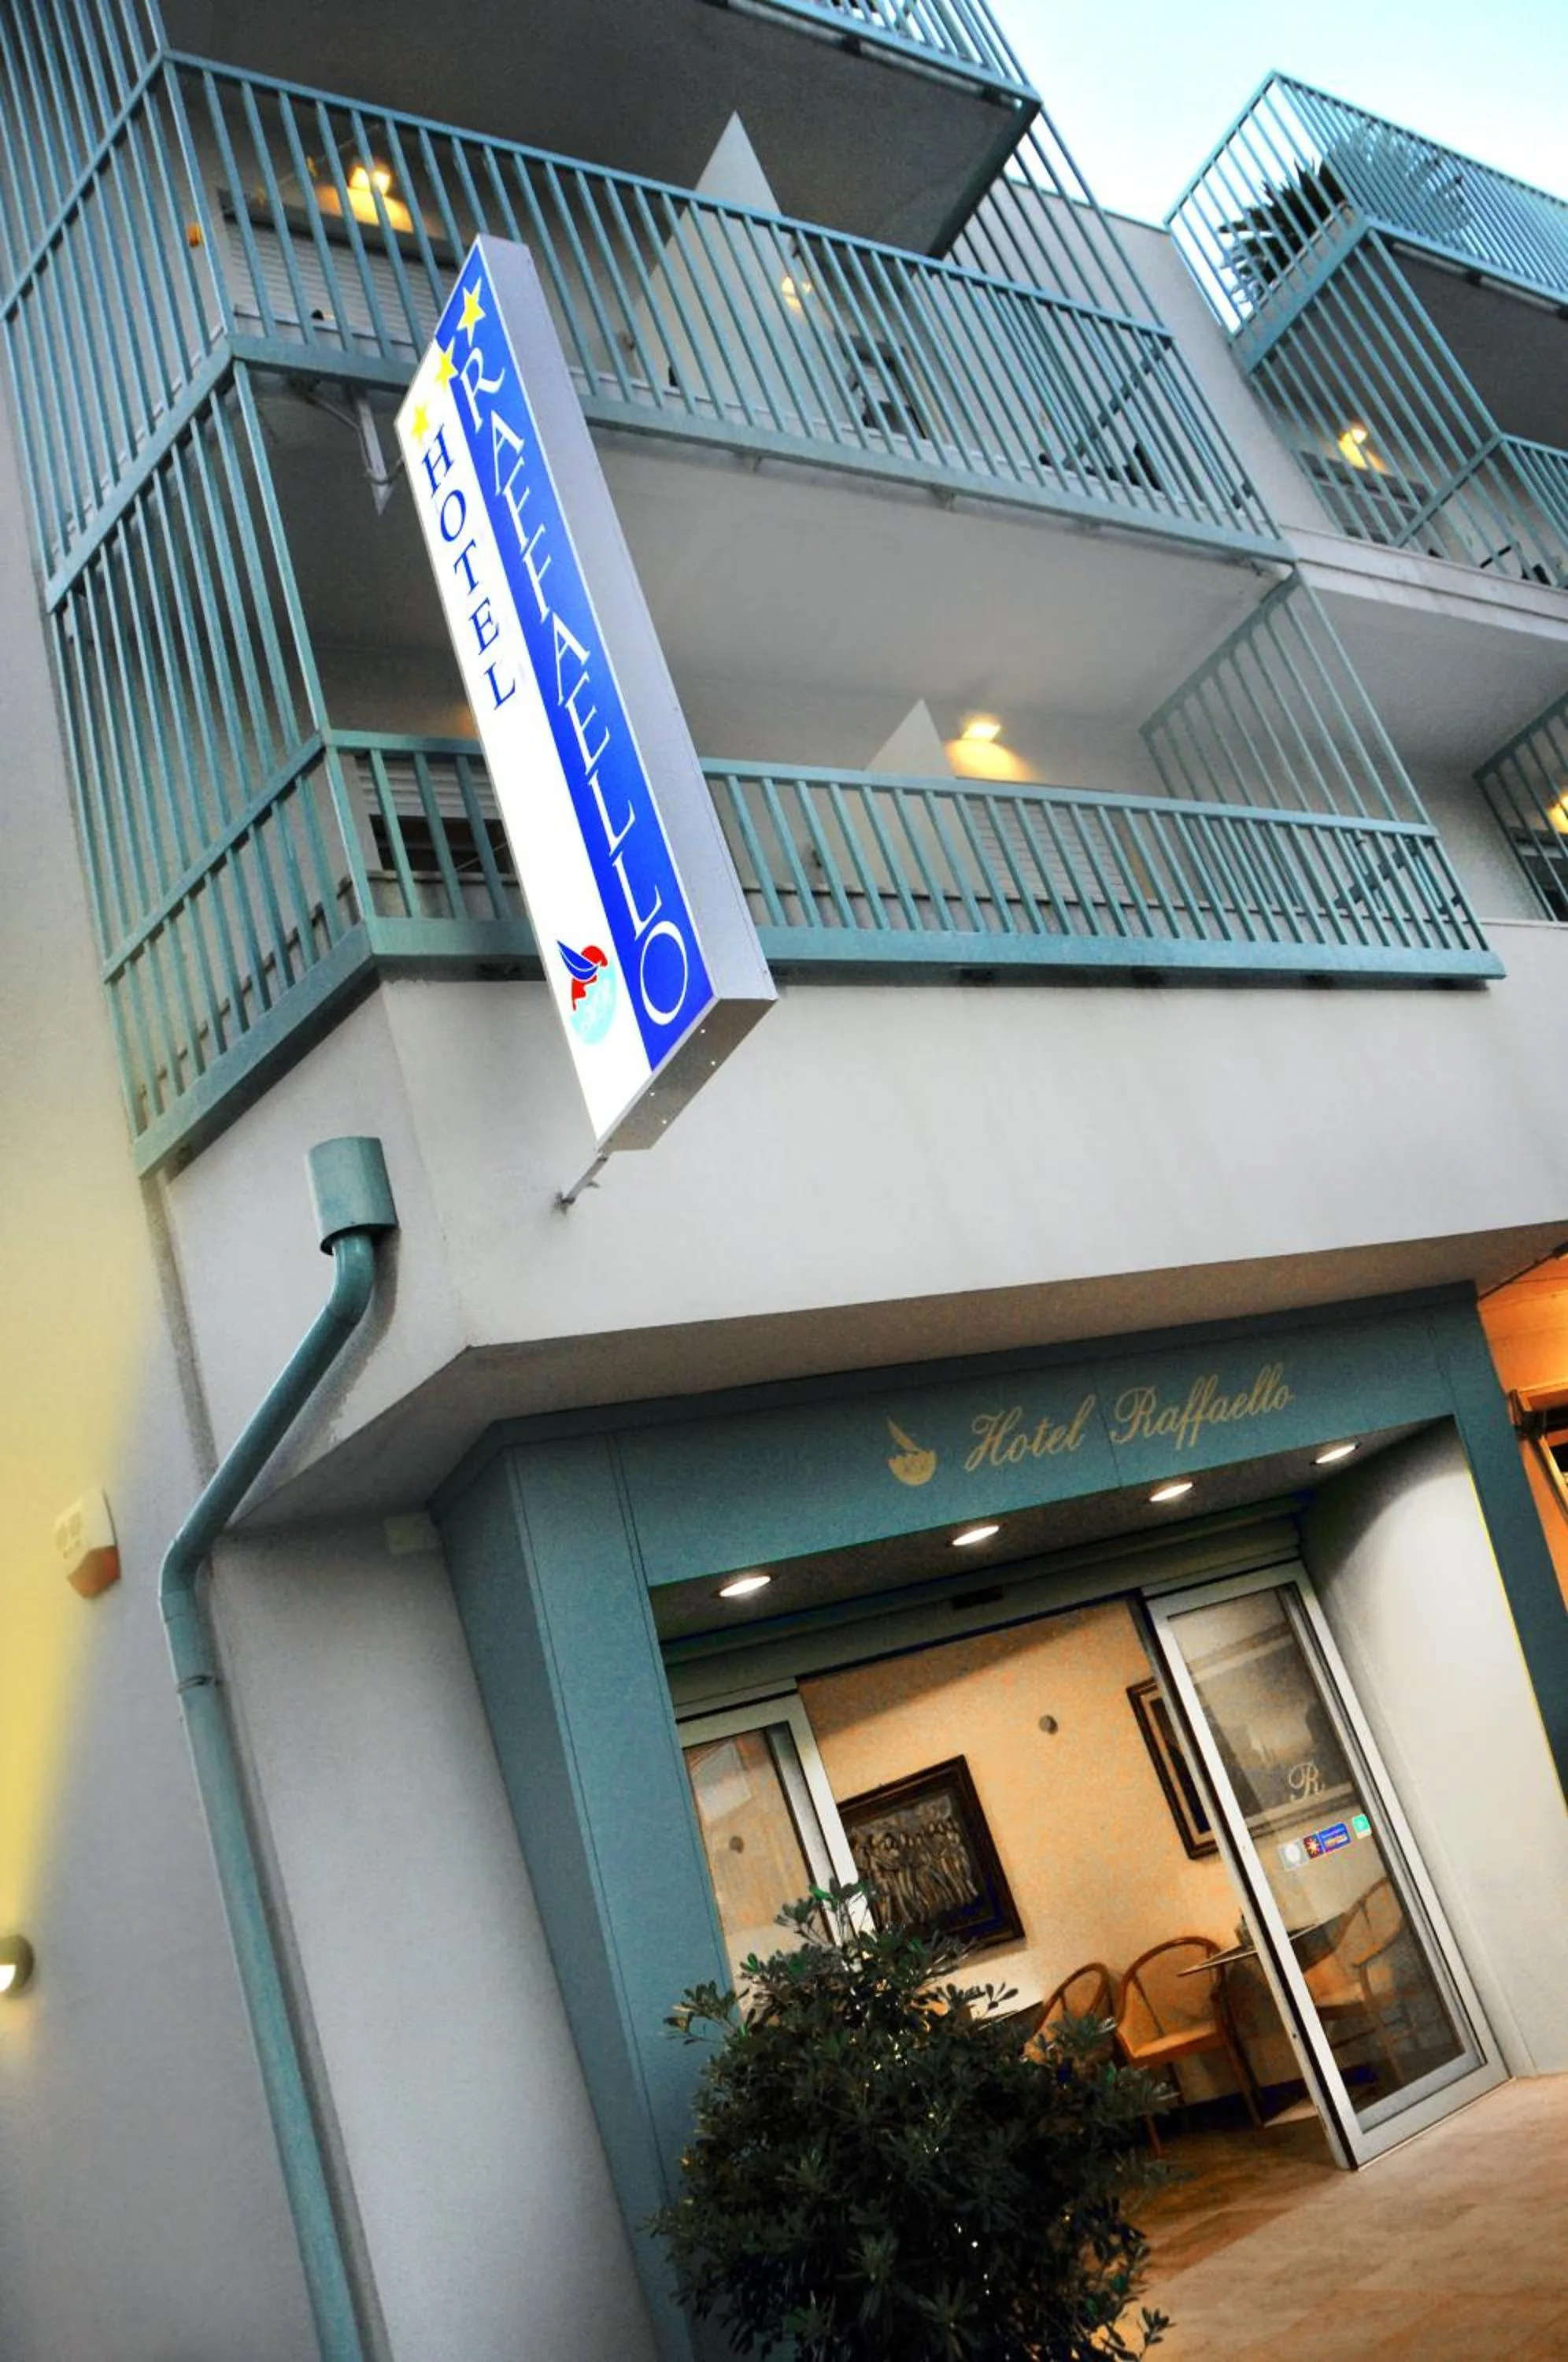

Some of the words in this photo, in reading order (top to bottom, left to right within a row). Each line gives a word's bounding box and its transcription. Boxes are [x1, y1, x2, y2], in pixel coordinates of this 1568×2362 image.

[421, 423, 516, 710] HOTEL
[460, 347, 688, 1026] RAFFAELLO
[966, 1395, 1094, 1471] Hotel
[1110, 1363, 1292, 1449] Raffaello
